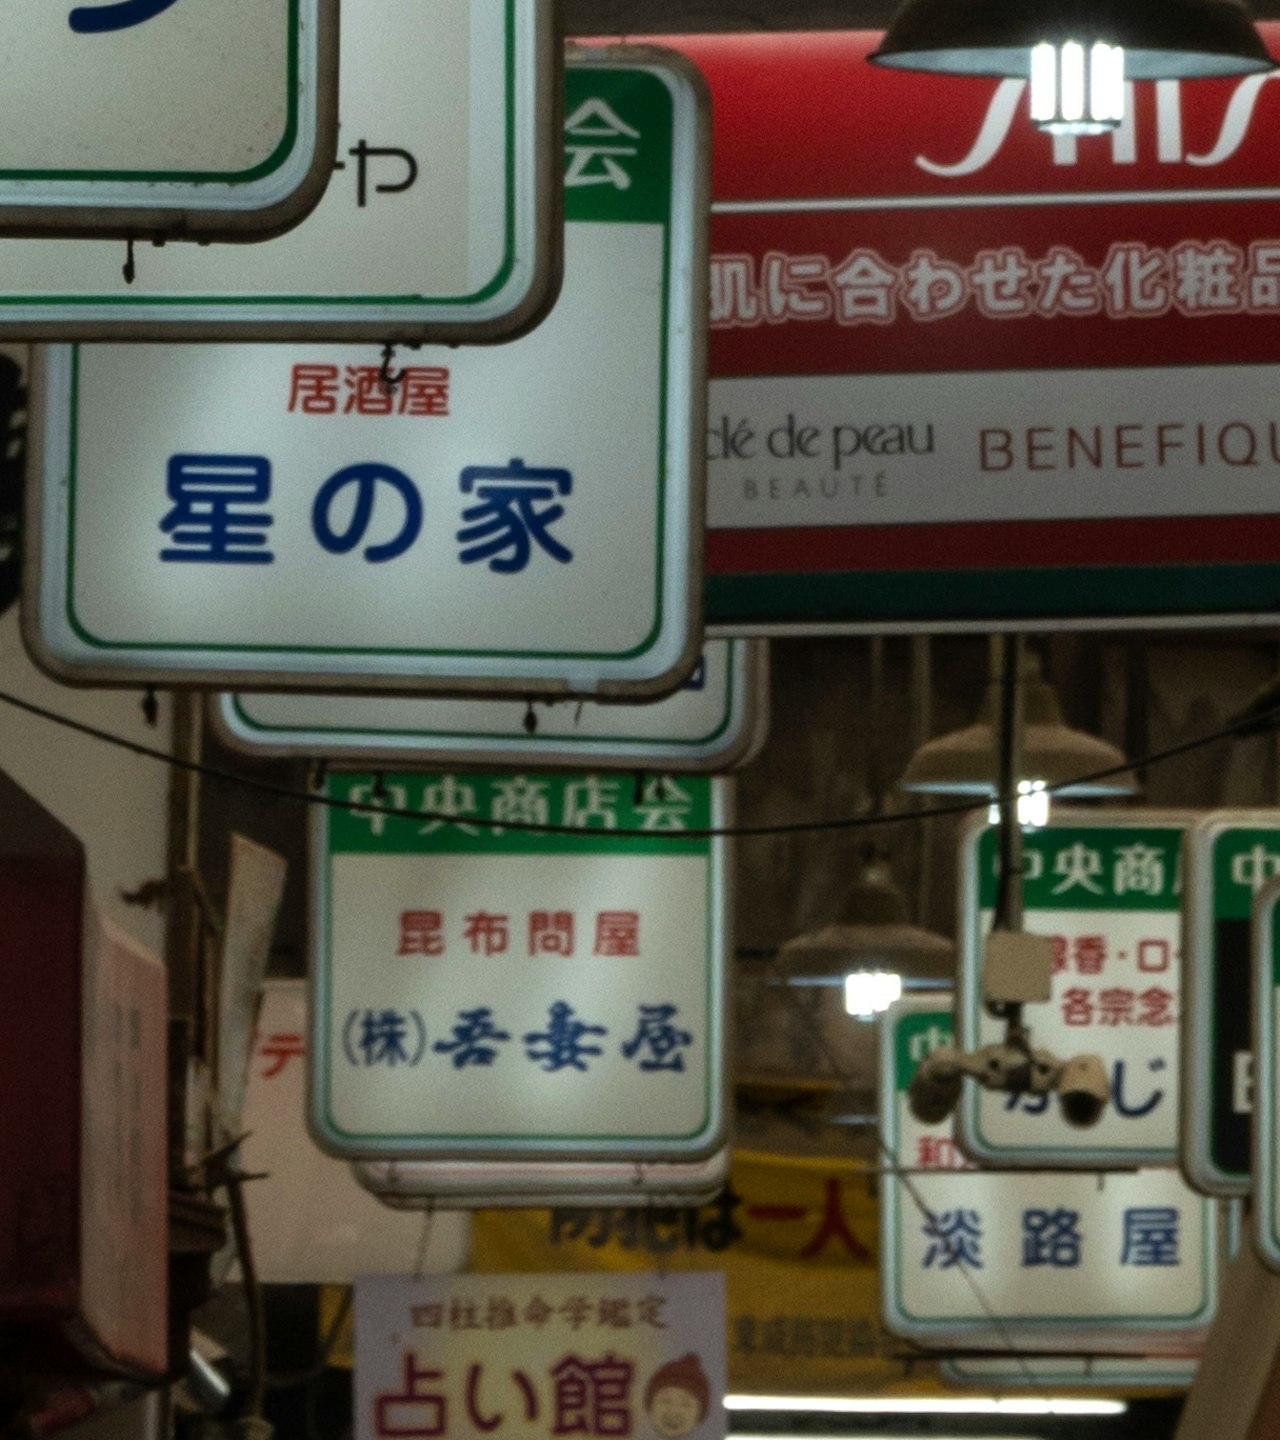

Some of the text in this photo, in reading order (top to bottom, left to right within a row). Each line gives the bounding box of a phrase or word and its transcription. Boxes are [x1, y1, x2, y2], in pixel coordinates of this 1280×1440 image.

[565, 96, 641, 191] 会
[287, 362, 450, 417] 居酒屋
[158, 453, 574, 576] 星の家
[345, 774, 694, 839] 中央商店会
[991, 841, 1183, 897] 中央商
[396, 909, 641, 958] 昆布問屋
[922, 1206, 1181, 1270] 淡路屋
[374, 1351, 635, 1438] 占い館
